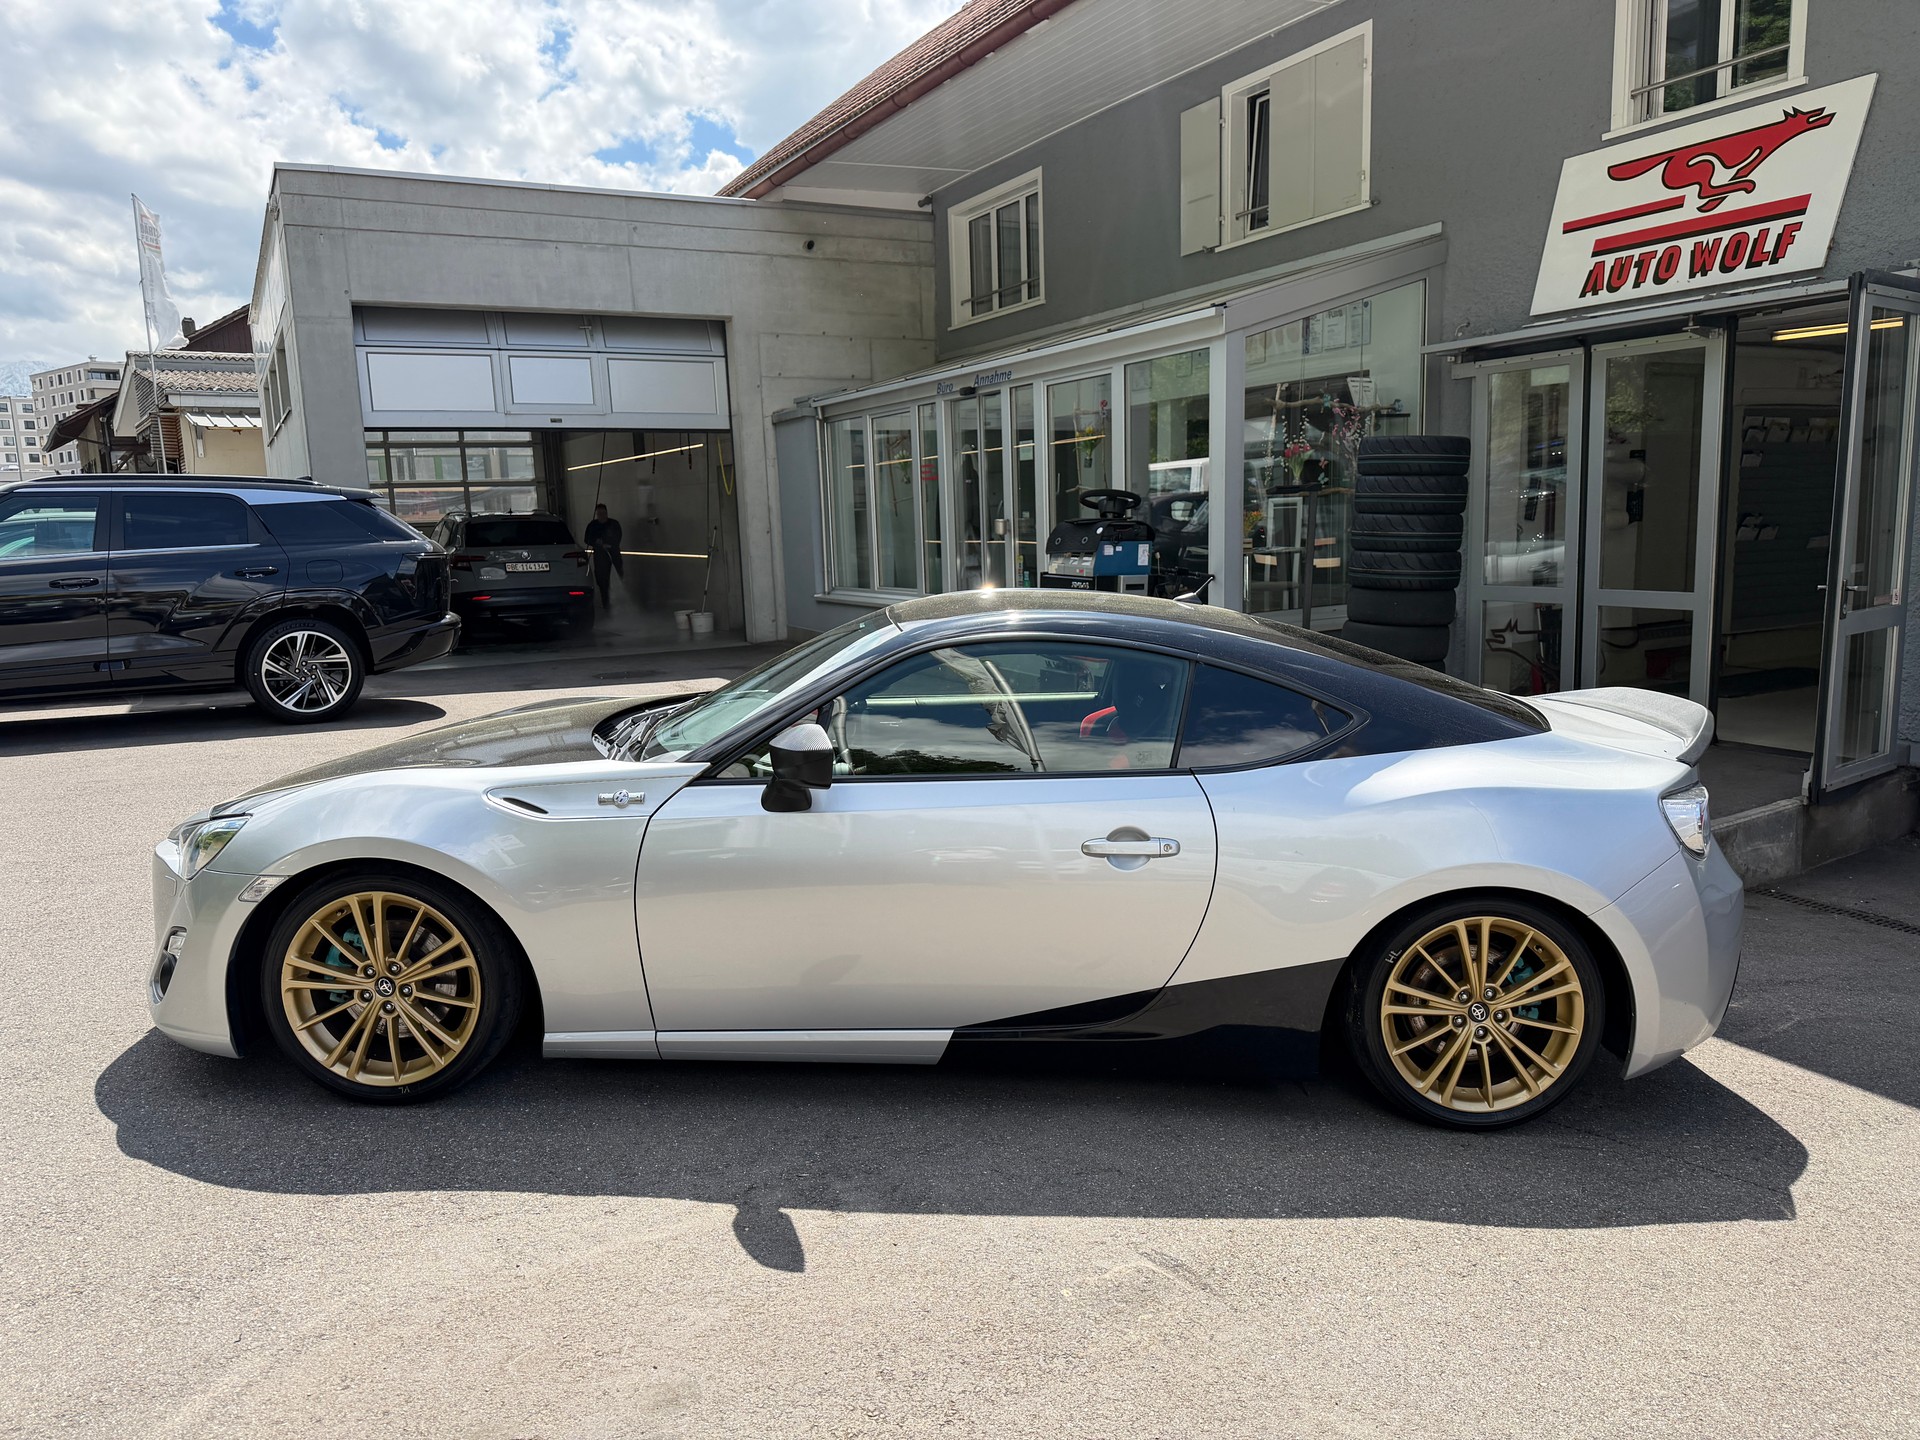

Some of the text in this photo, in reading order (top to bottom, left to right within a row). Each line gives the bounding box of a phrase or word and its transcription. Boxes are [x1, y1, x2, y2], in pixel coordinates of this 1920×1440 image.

[1579, 221, 1803, 298] AUTO WOLF
[937, 370, 1012, 394] Büro Annahme
[1385, 949, 1403, 964] HL
